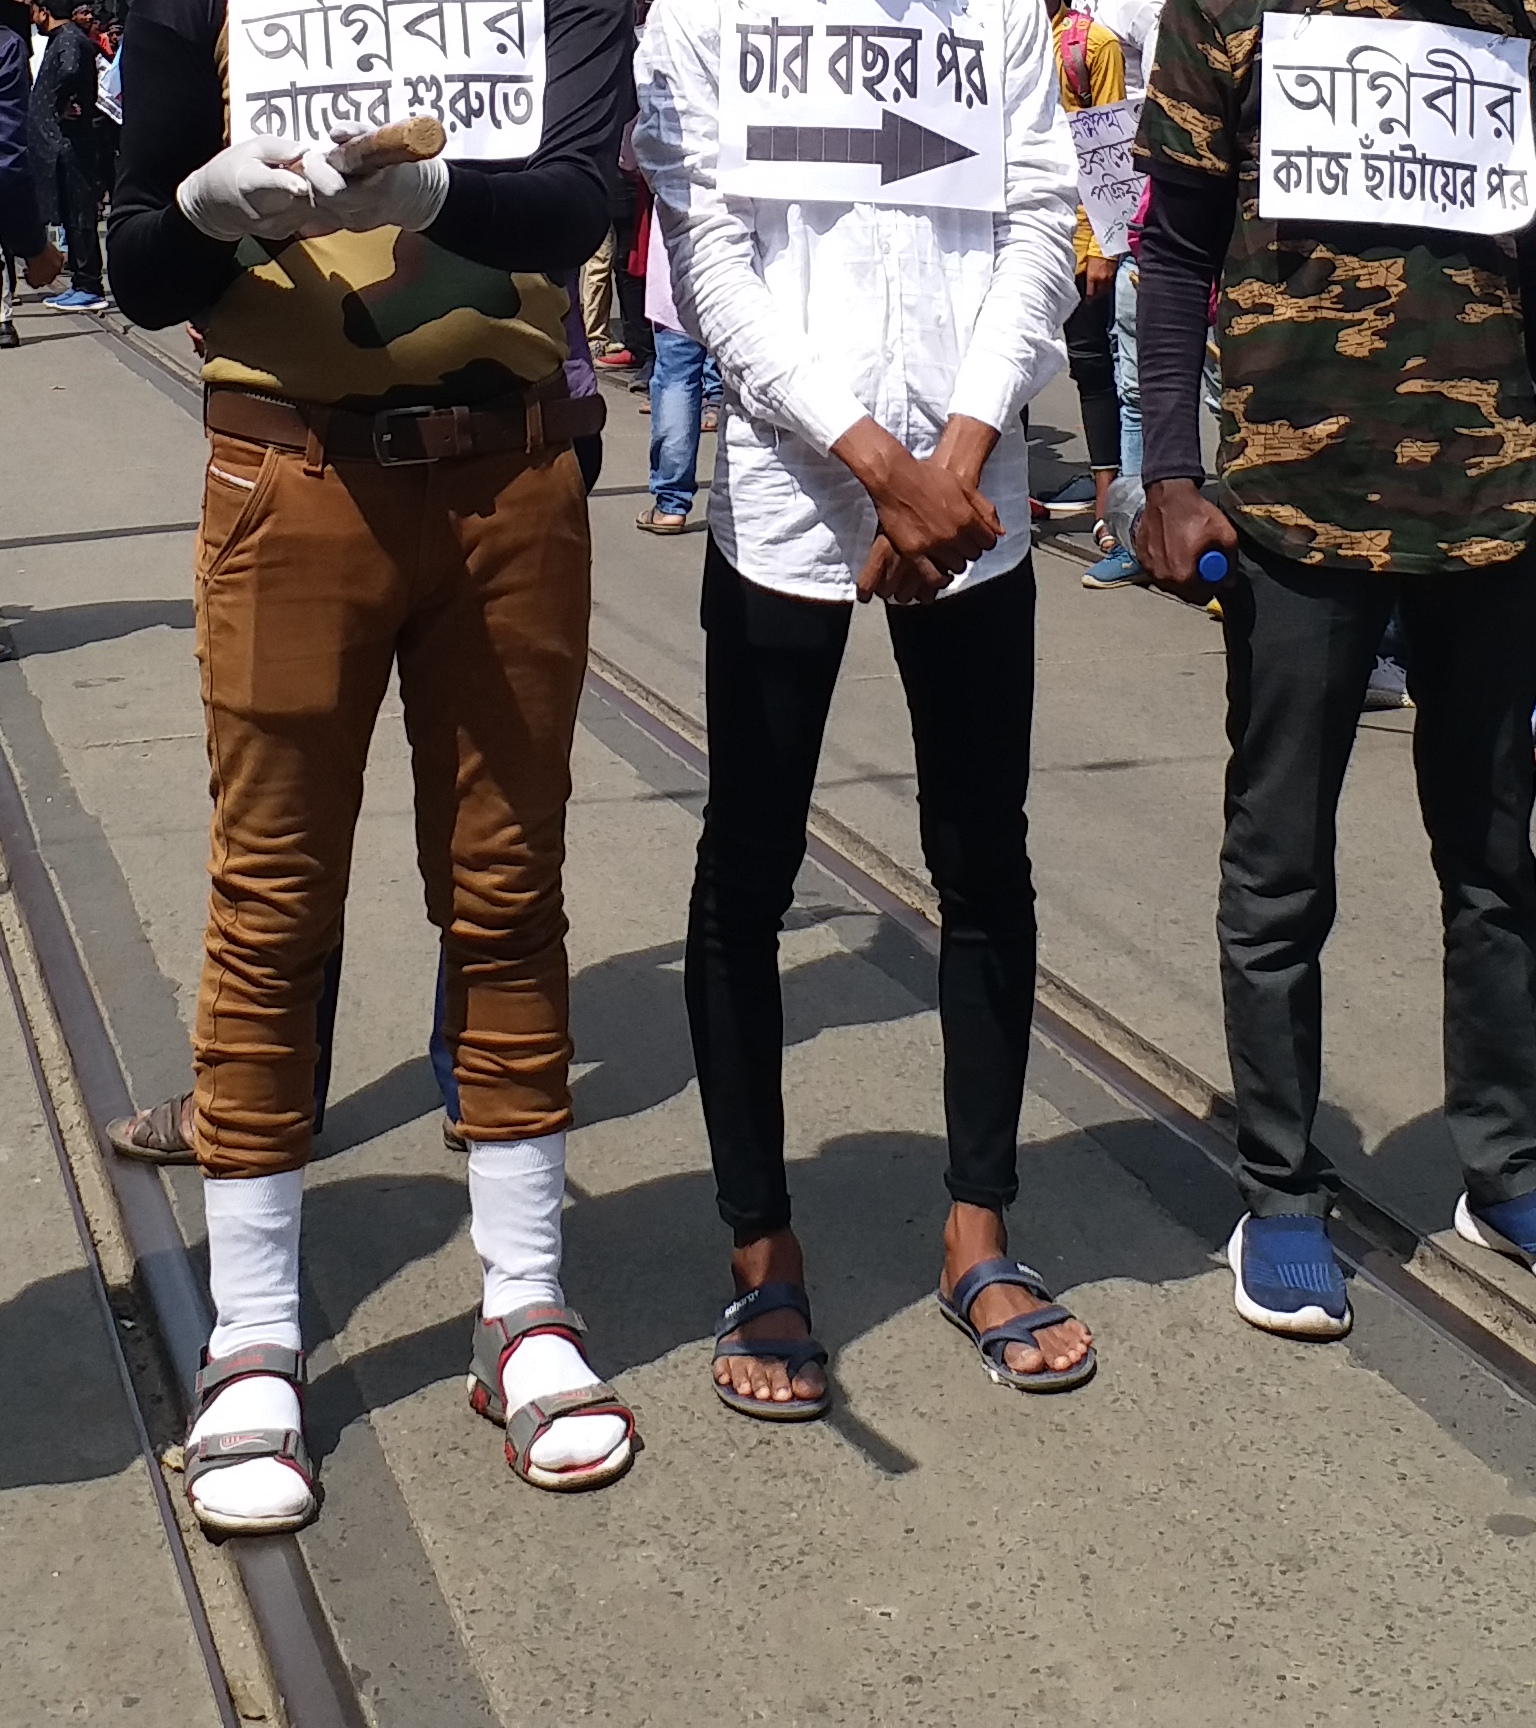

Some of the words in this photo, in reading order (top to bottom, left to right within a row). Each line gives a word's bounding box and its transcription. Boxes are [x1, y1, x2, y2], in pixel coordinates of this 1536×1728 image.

[735, 17, 813, 99] চার
[826, 25, 922, 103] বছর
[935, 27, 988, 109] পর
[1272, 45, 1522, 145] অগ্নিবীর
[1271, 145, 1352, 195] কাজ
[1487, 162, 1528, 211] পর
